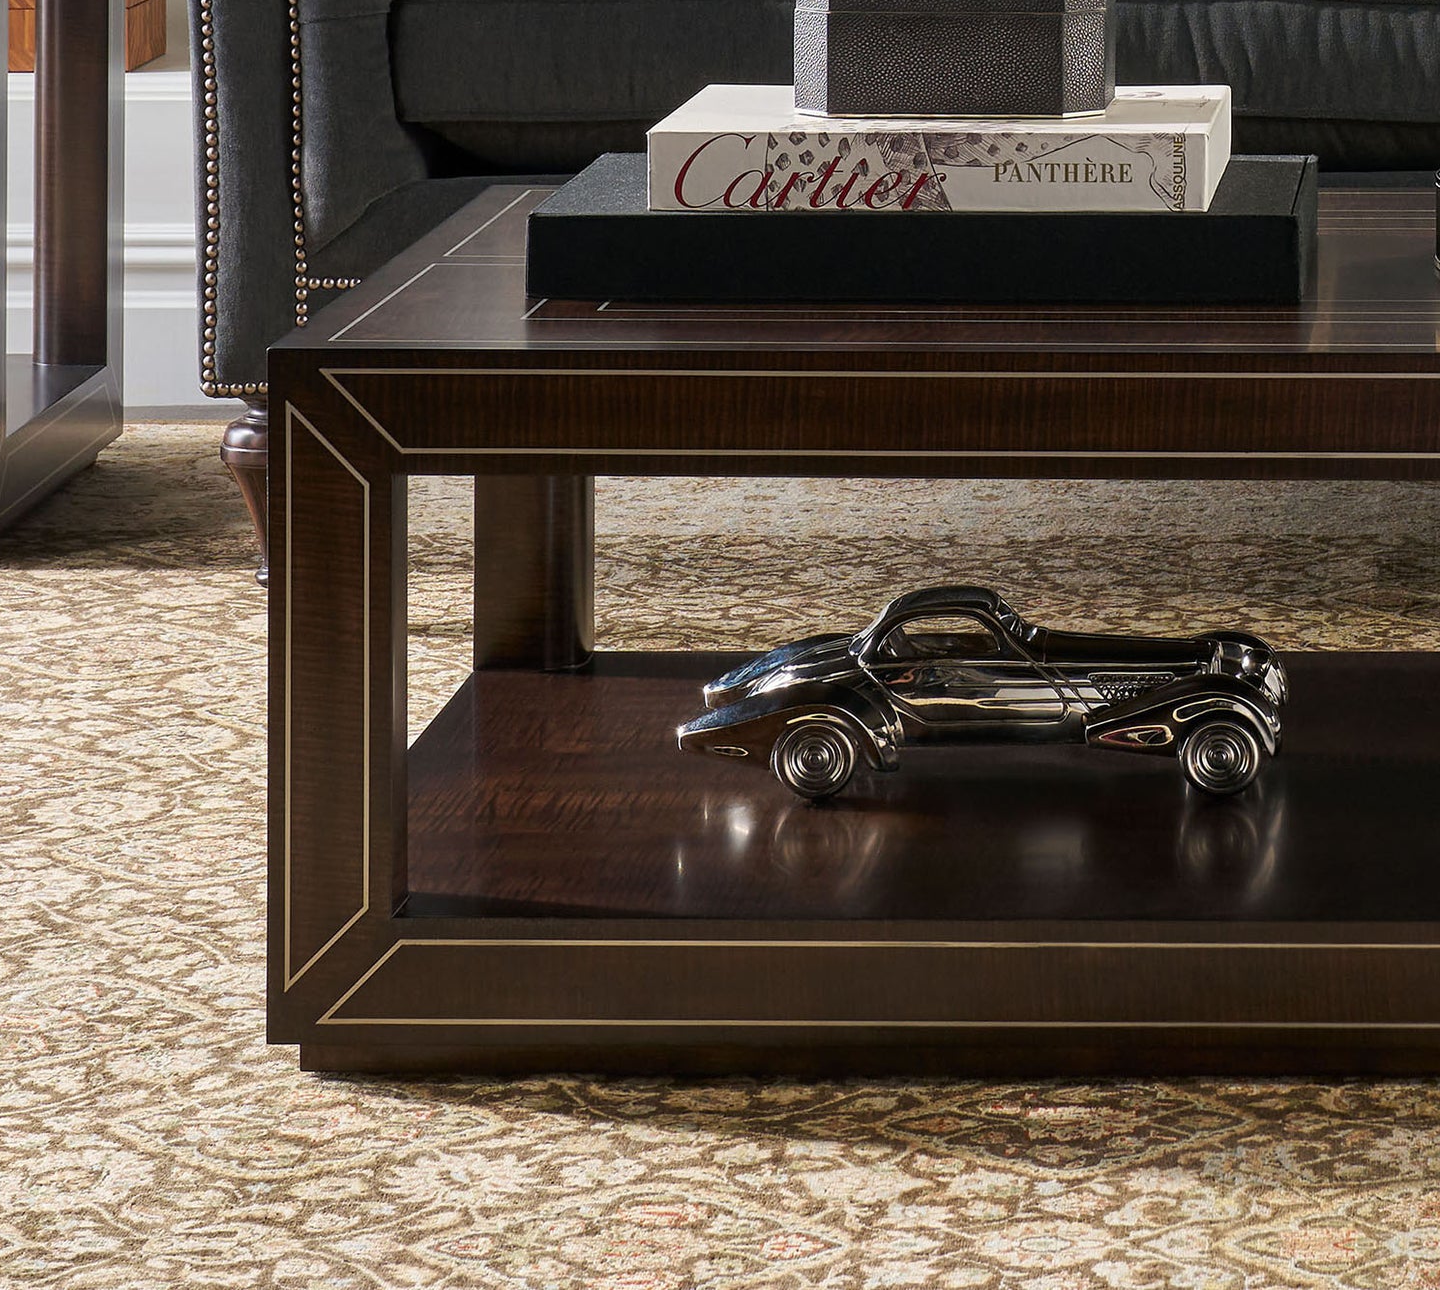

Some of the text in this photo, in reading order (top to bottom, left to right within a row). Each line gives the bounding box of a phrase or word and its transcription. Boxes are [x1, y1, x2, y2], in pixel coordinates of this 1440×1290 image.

[673, 132, 1134, 210] Cartier PANTHÈRE
[1172, 135, 1186, 212] ASSOULINE
